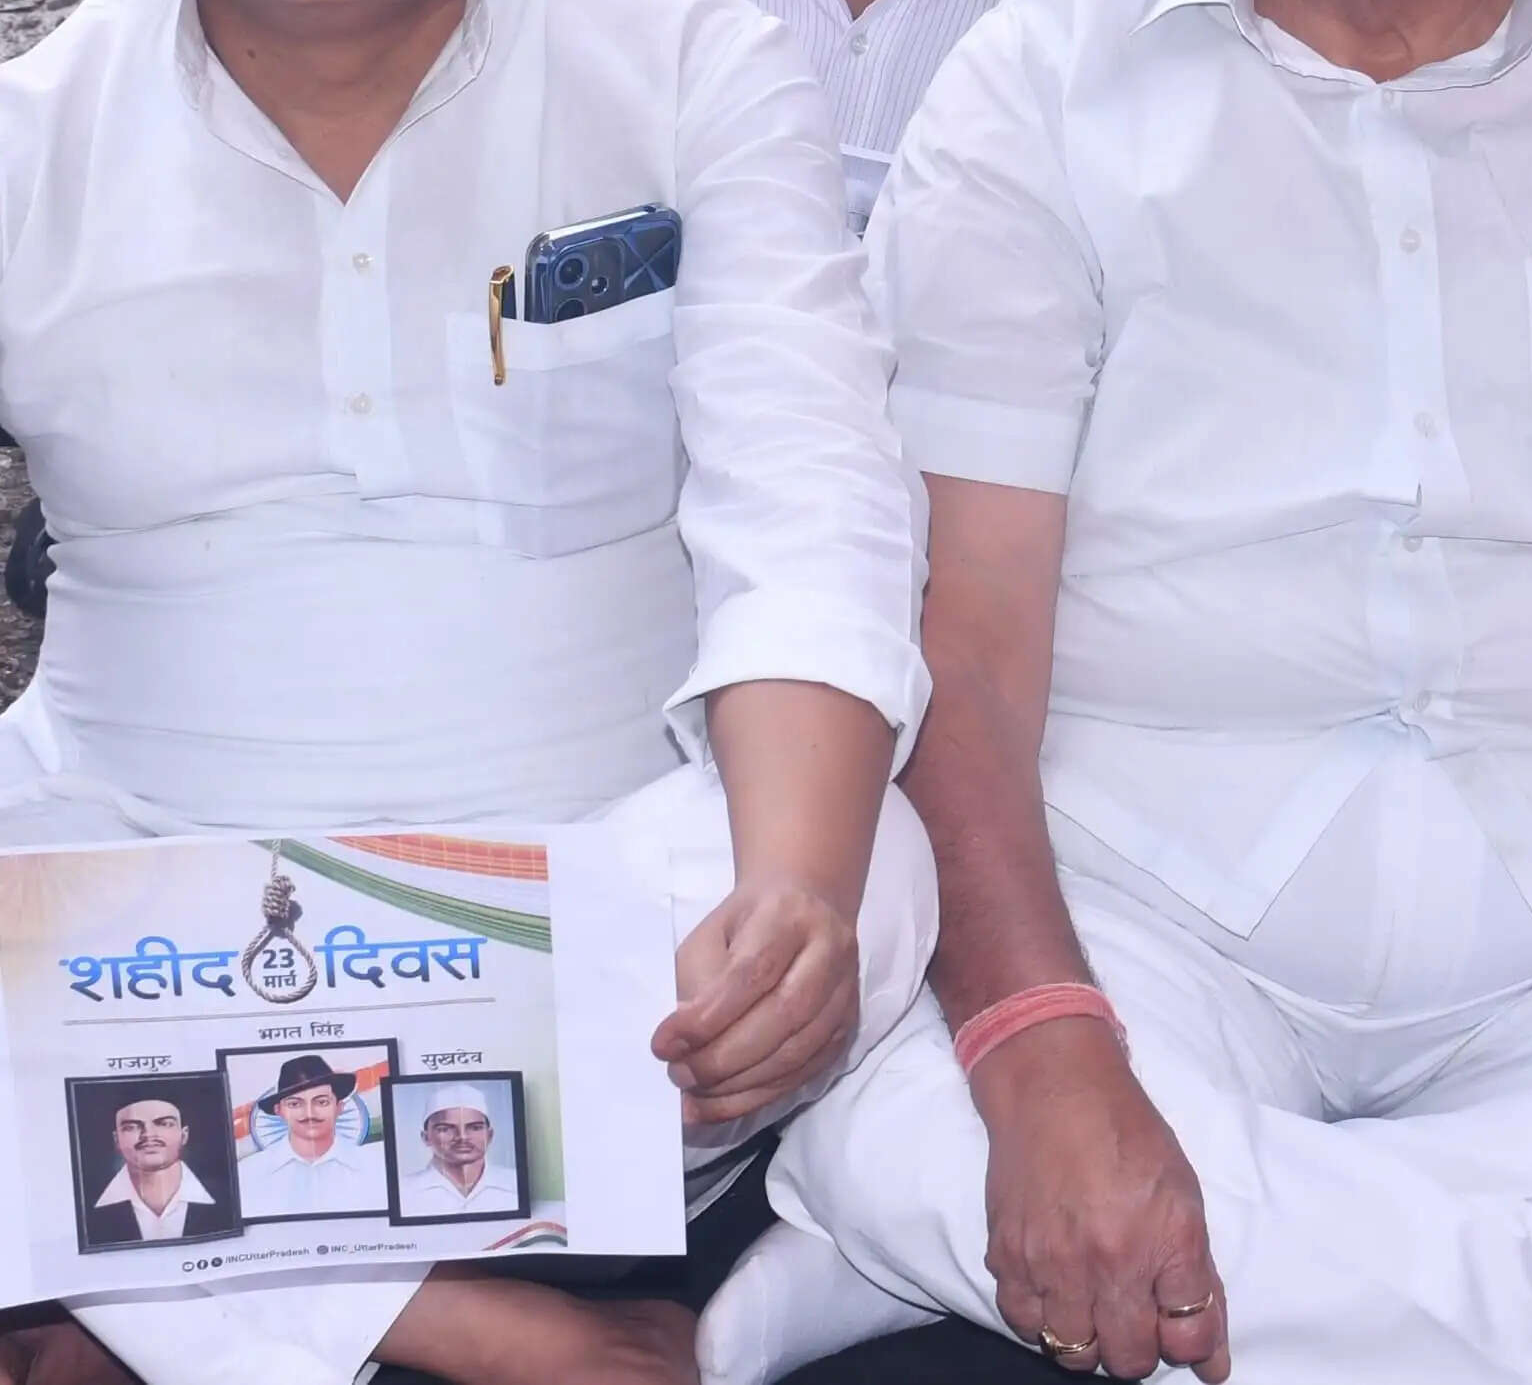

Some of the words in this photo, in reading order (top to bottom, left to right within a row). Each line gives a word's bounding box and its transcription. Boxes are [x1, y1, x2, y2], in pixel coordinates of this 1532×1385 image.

[59, 936, 241, 1002] शहीद
[314, 924, 487, 987] दिवस
[264, 949, 295, 971] 23
[264, 970, 297, 989] मार्च
[258, 1024, 302, 1041] भगत
[310, 1022, 344, 1039] सिंह
[107, 1054, 172, 1073] राजगुरु
[421, 1049, 483, 1070] सुखदेव
